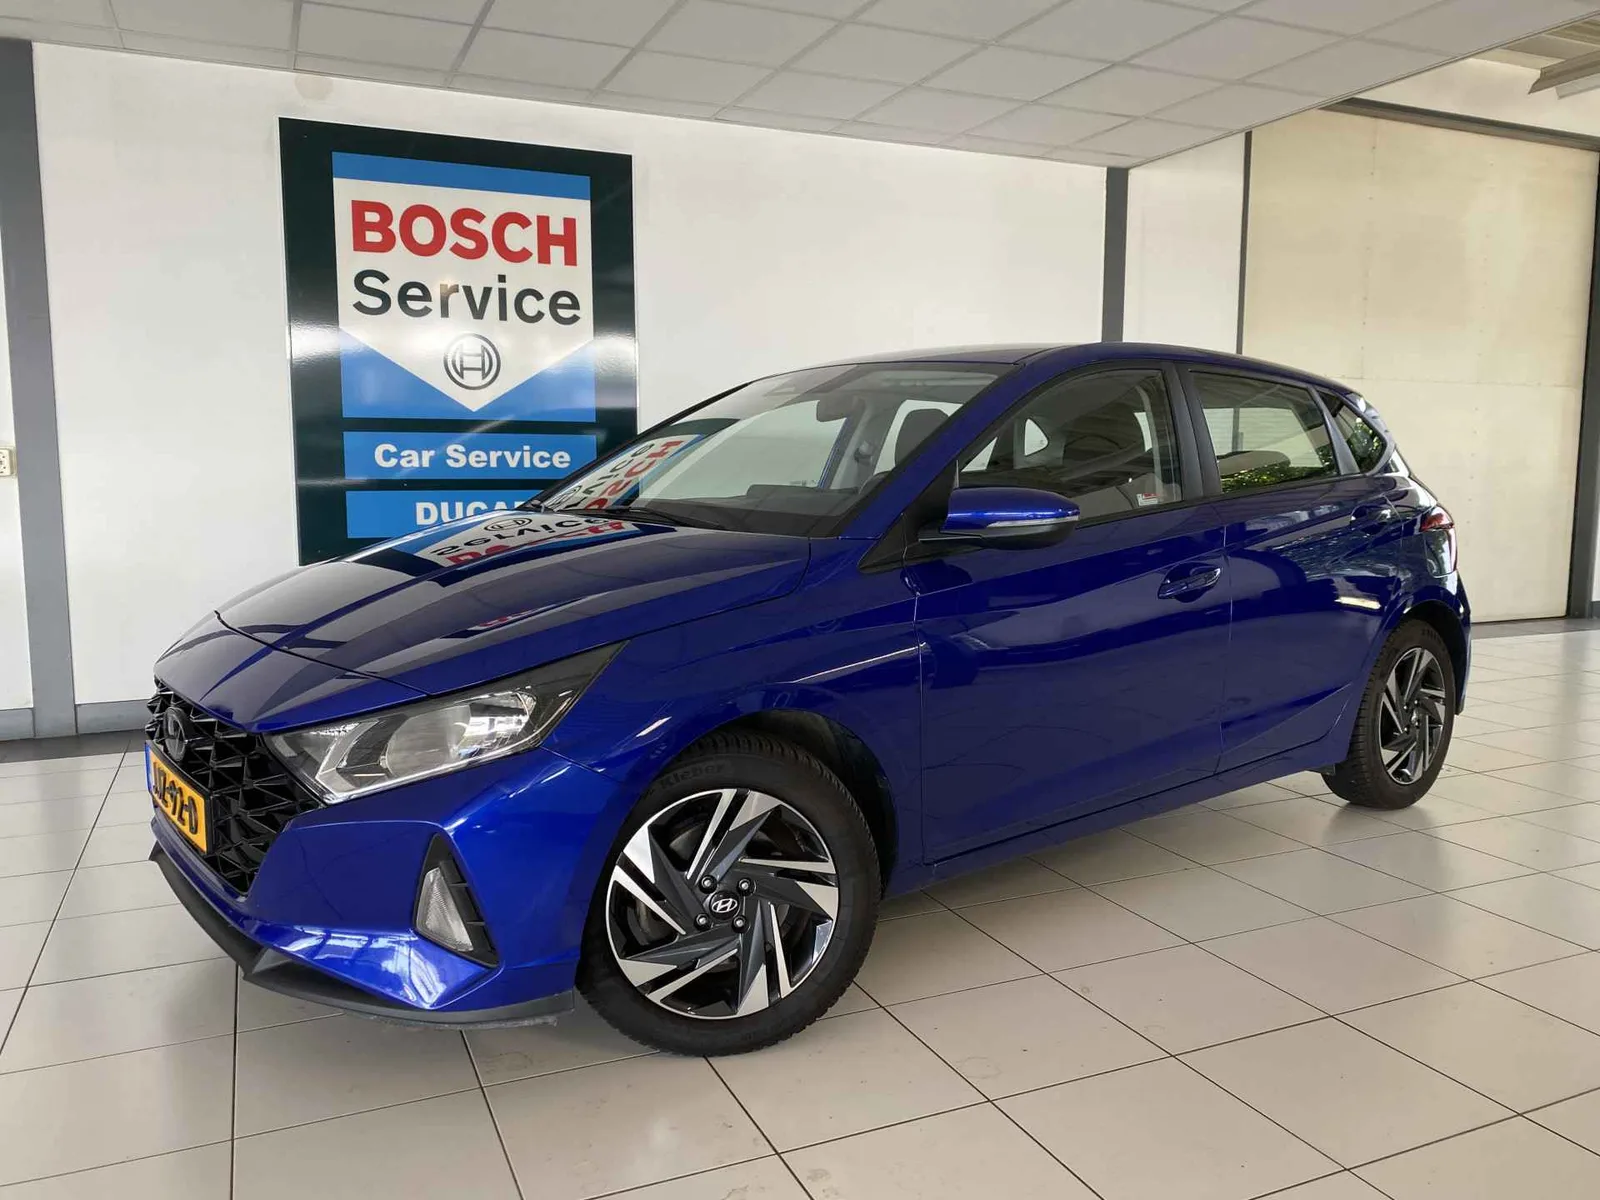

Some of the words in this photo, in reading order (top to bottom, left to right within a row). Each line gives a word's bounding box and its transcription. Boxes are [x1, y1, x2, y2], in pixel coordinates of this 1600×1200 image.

[351, 199, 578, 267] BOSCH
[352, 269, 582, 326] Service
[374, 443, 436, 468] Car
[445, 444, 572, 469] Service
[660, 763, 726, 788] Kleber
